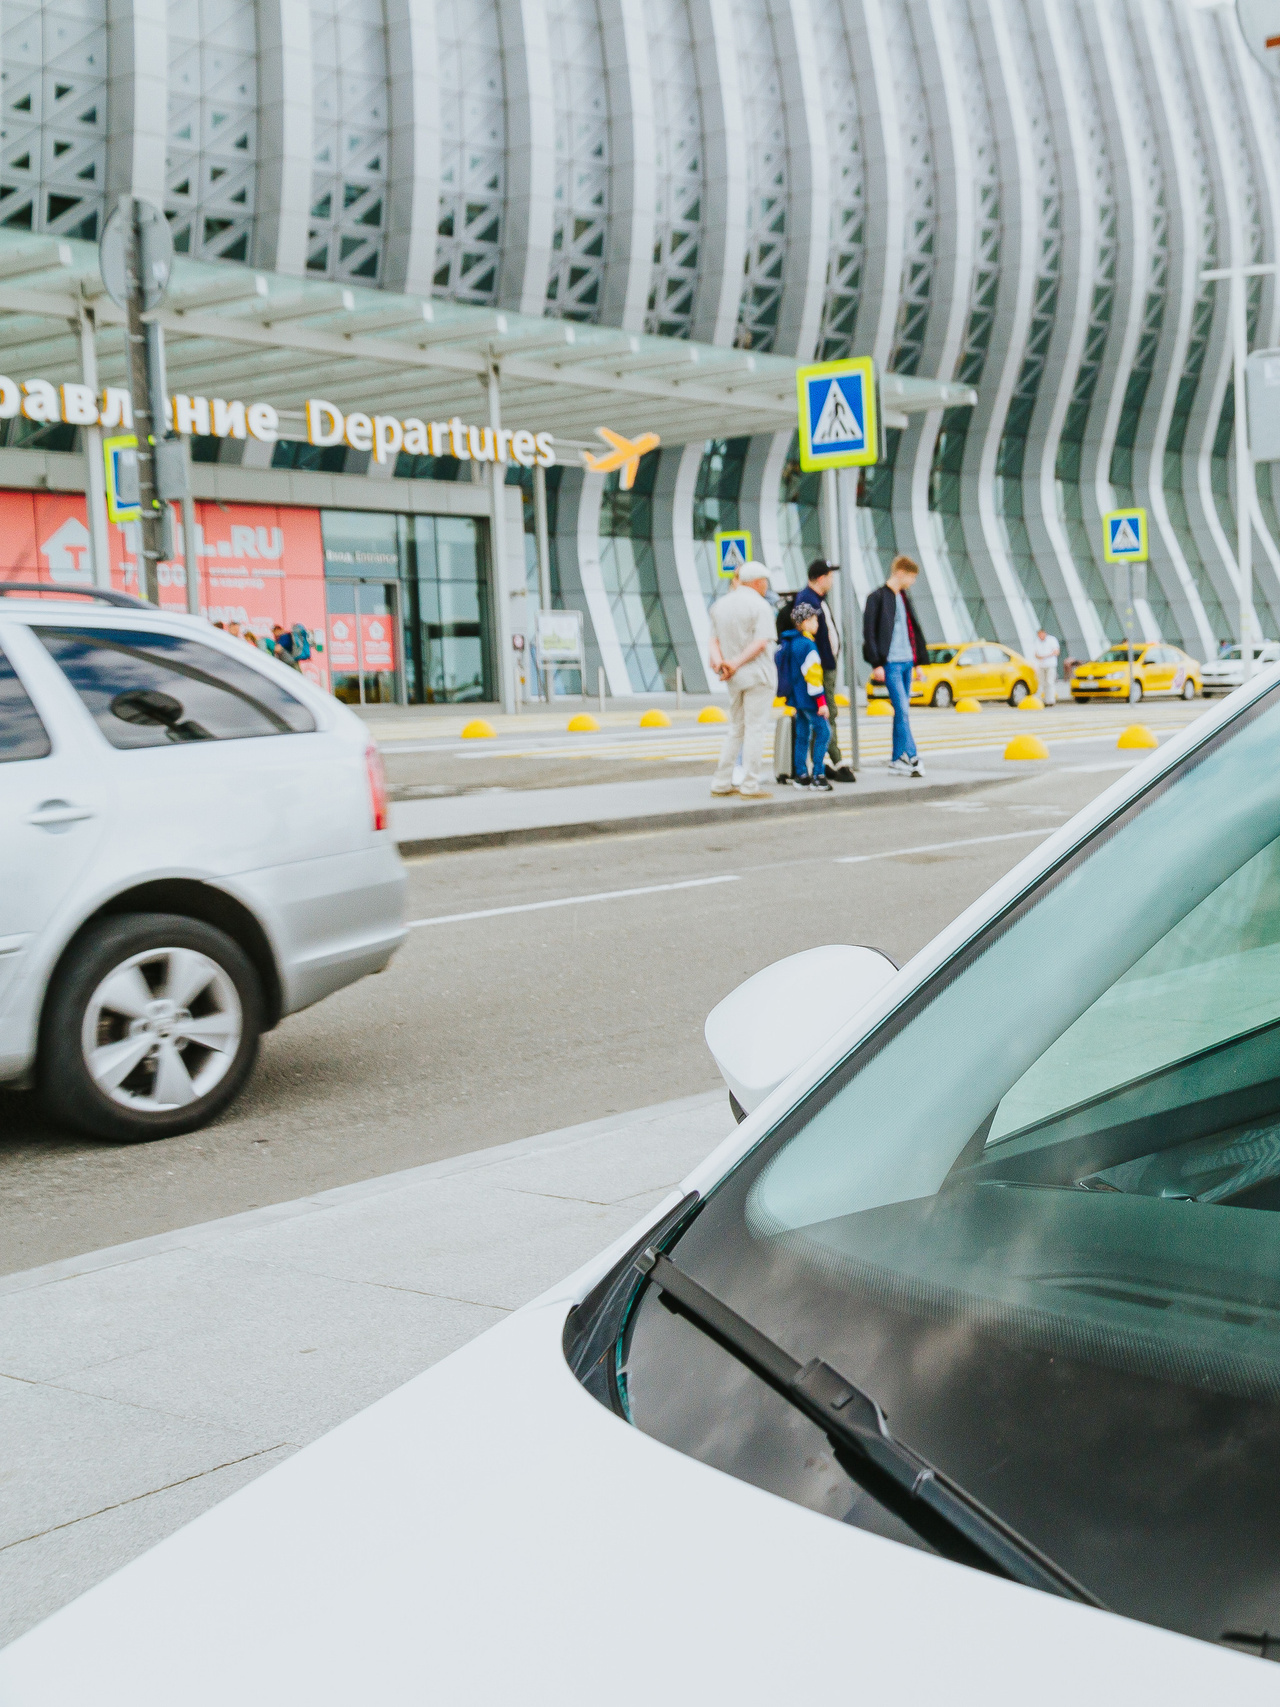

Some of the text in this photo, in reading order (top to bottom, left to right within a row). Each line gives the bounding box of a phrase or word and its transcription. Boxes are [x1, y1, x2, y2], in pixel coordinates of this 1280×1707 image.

[0, 375, 279, 442] авлние
[306, 399, 556, 467] Departures
[117, 520, 283, 559] TIL.RU
